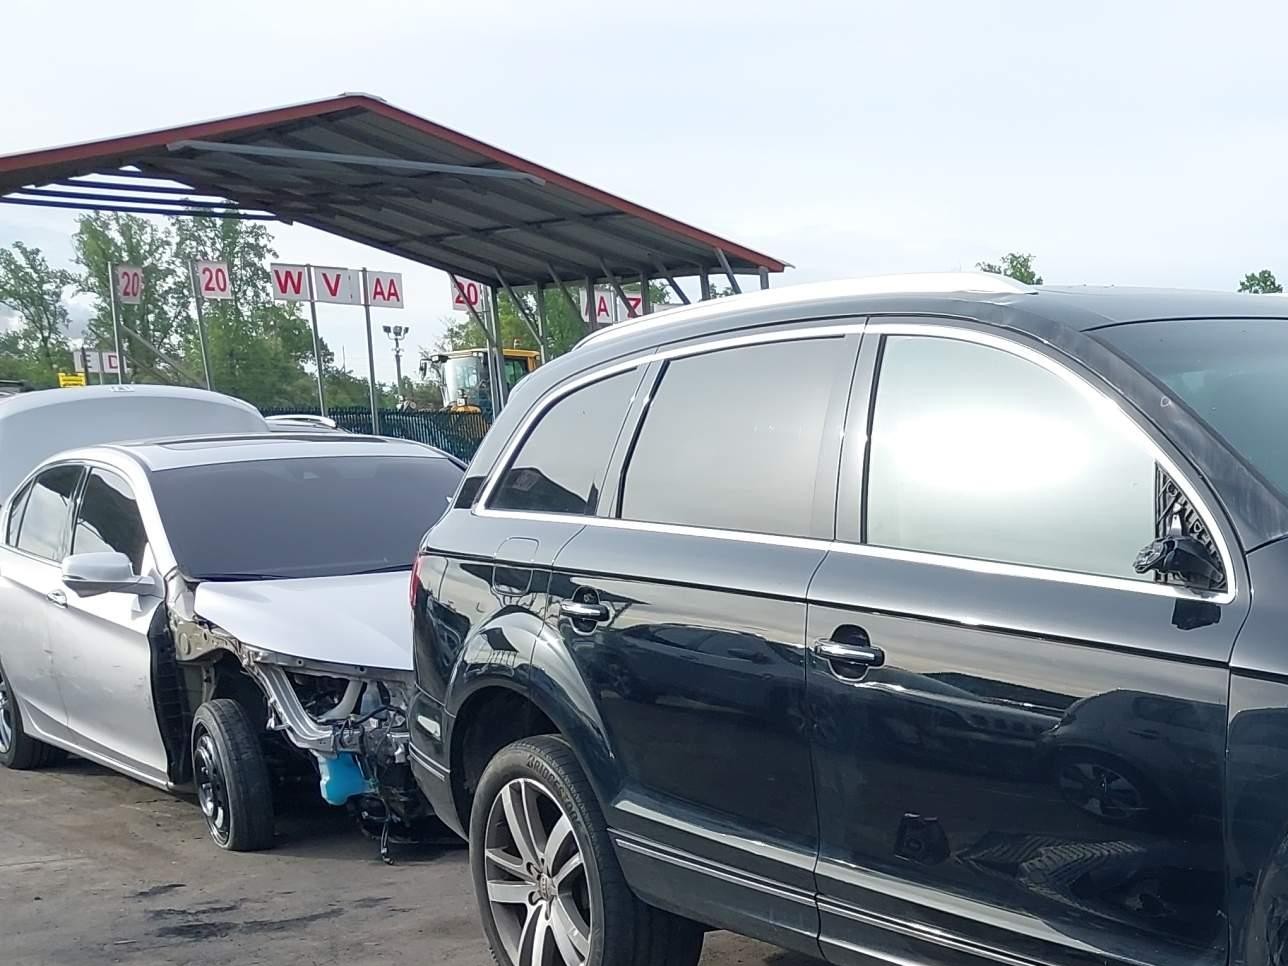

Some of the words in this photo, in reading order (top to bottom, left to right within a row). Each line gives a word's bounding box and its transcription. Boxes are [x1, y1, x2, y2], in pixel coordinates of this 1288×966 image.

[121, 271, 140, 297] 20
[202, 266, 227, 292] 20
[273, 269, 303, 295] W
[322, 272, 341, 297] V
[372, 277, 400, 302] AA
[454, 281, 478, 305] 20
[585, 295, 609, 318] A
